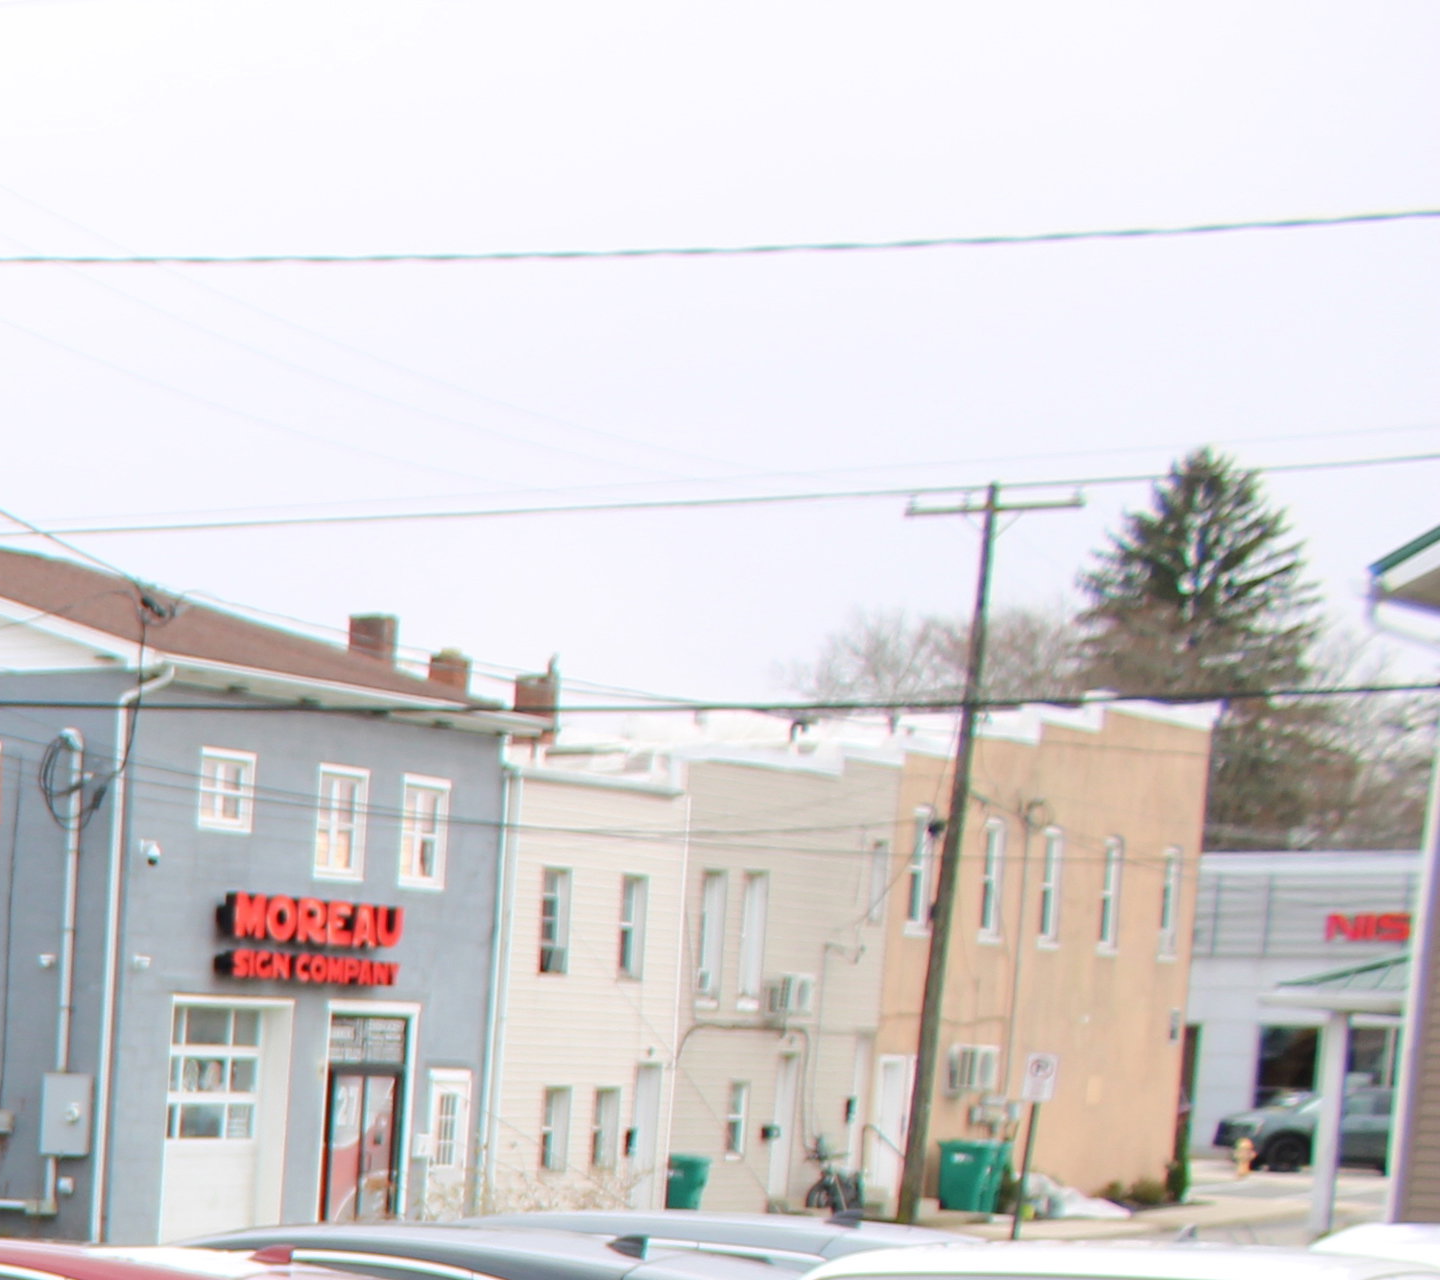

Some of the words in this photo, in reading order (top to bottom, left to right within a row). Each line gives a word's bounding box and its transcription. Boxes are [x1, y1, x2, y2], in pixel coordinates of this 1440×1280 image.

[233, 890, 405, 948] MOREAU
[233, 948, 291, 980] SIGN
[295, 953, 402, 986] COMPANY
